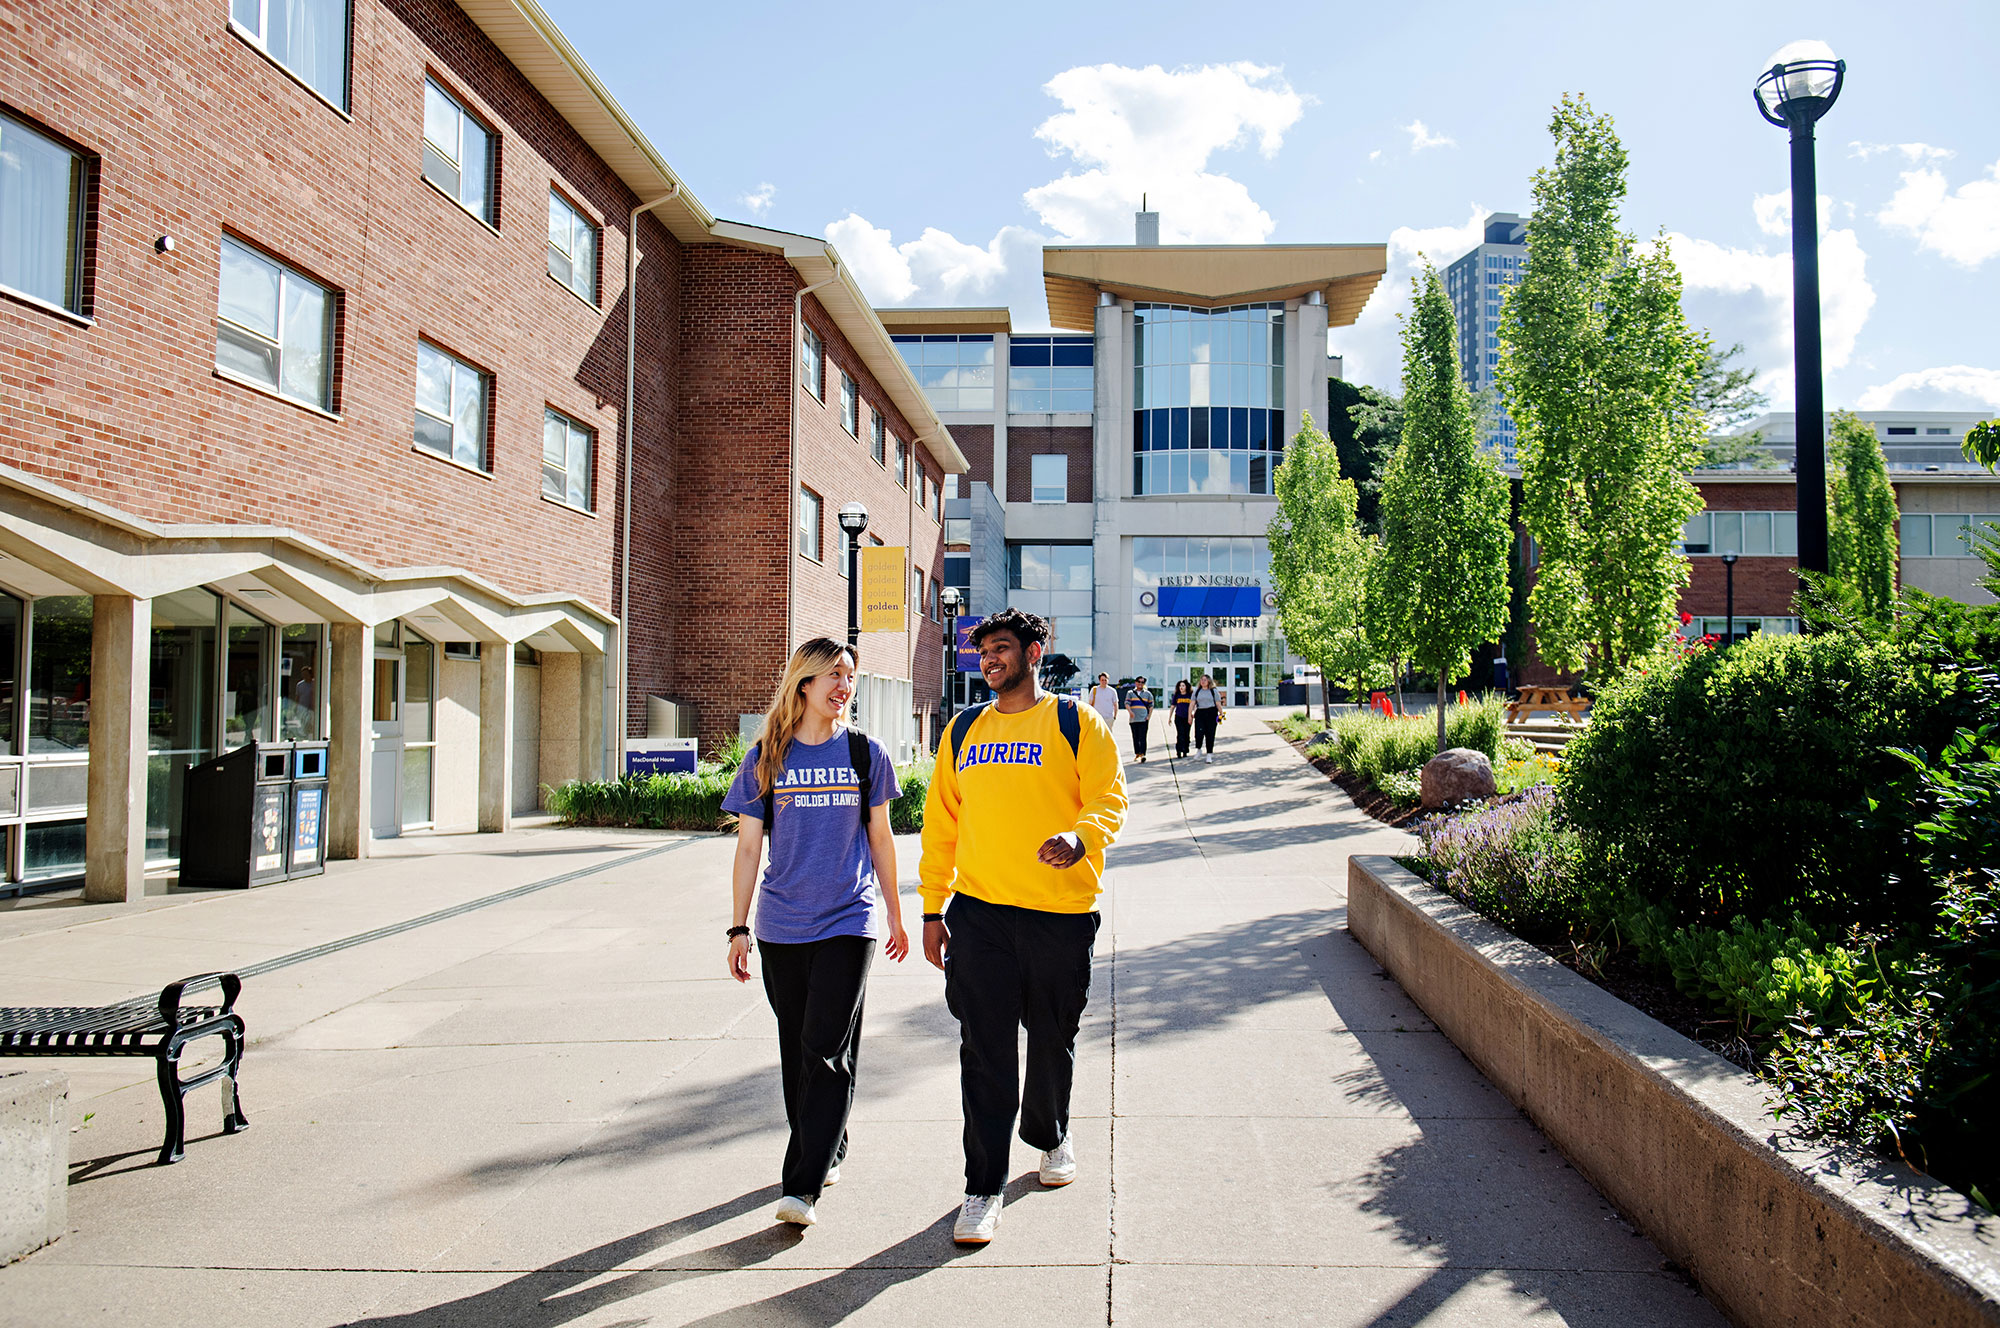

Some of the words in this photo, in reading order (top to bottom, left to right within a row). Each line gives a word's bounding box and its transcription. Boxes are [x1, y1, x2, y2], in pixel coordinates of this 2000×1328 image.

[867, 562, 897, 572] golden
[867, 575, 897, 585] golden
[1159, 574, 1194, 586] FRED
[1198, 574, 1261, 587] NICHOLS
[867, 588, 897, 598] golden
[867, 602, 899, 612] golden
[867, 615, 897, 625] golden
[1160, 619, 1209, 629] CAMPUS
[1214, 619, 1258, 628] CENTRE
[794, 793, 830, 808] GOLDEN
[832, 793, 860, 807] HAWKS
